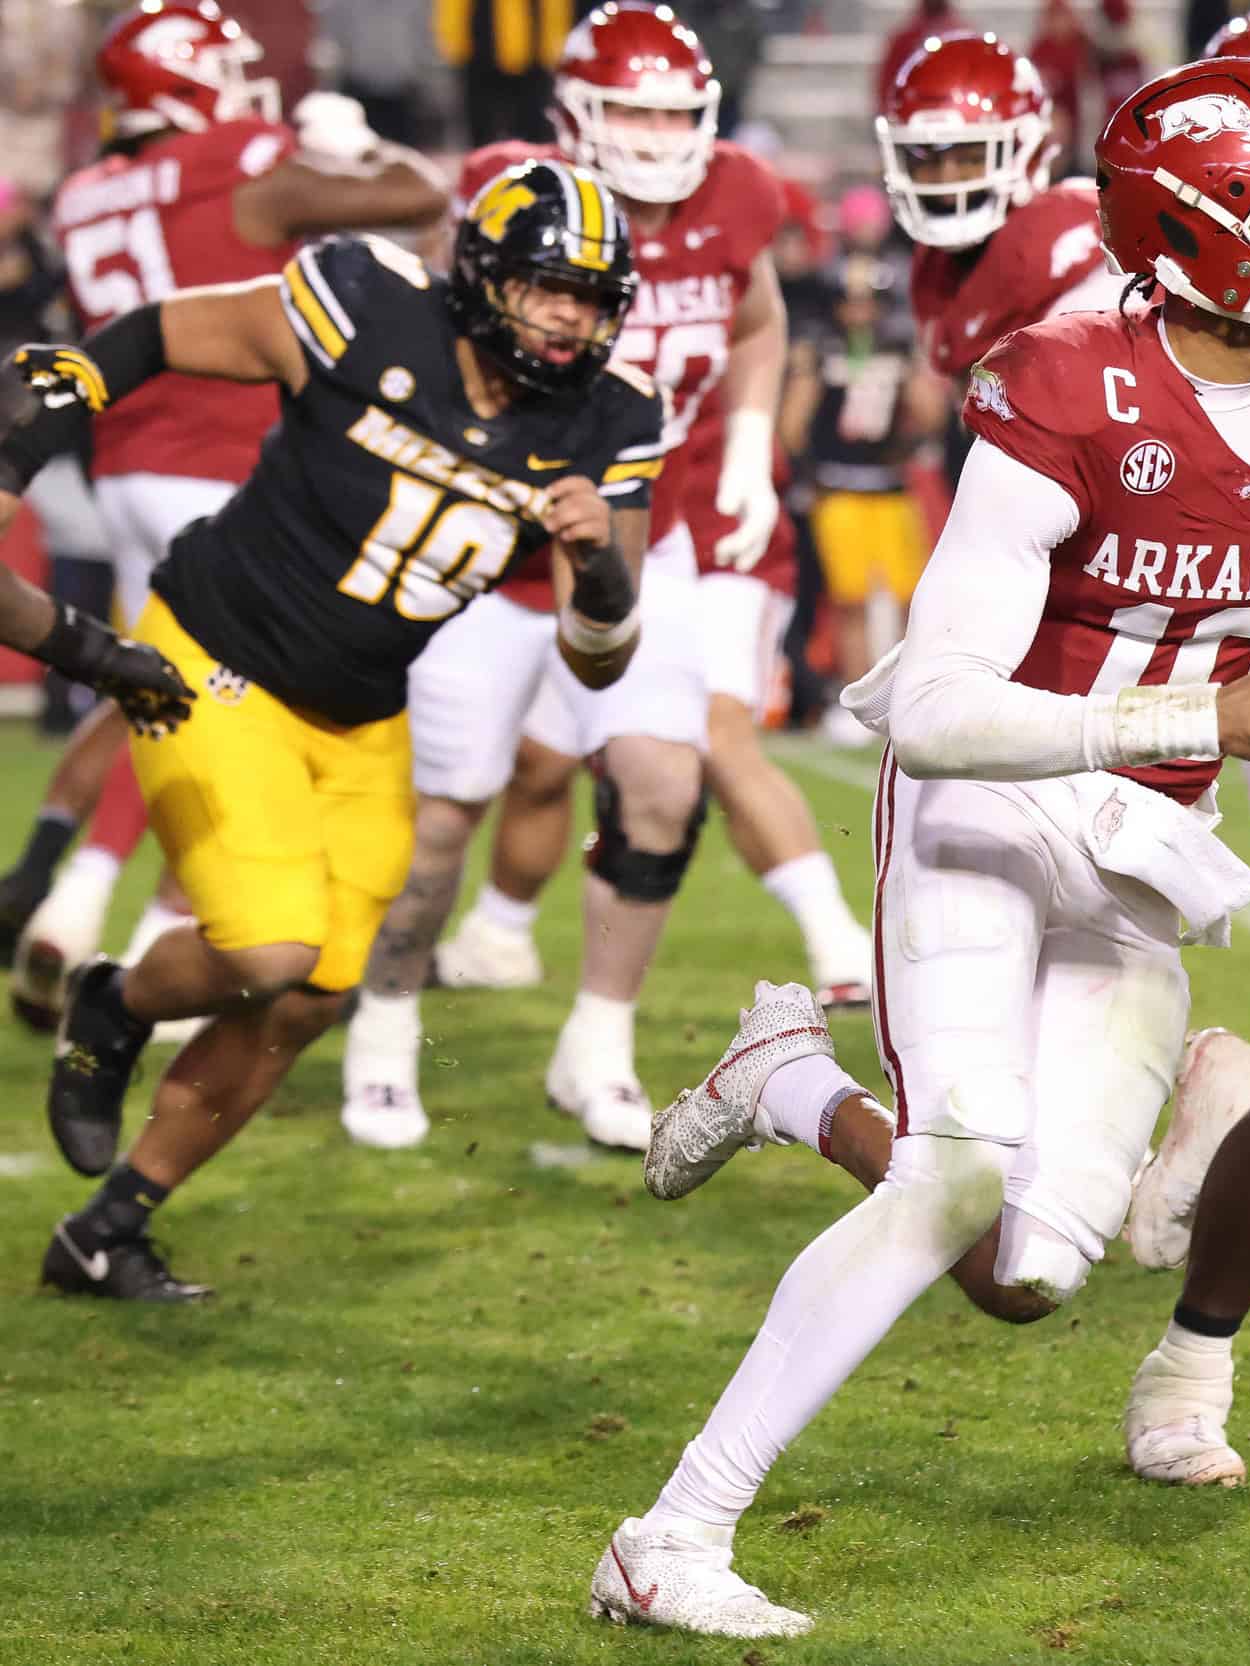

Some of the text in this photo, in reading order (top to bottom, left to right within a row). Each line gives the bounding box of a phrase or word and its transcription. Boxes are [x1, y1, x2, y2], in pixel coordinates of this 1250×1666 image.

[1103, 366, 1140, 425] C
[1125, 445, 1170, 490] SEC
[337, 471, 518, 622] 10
